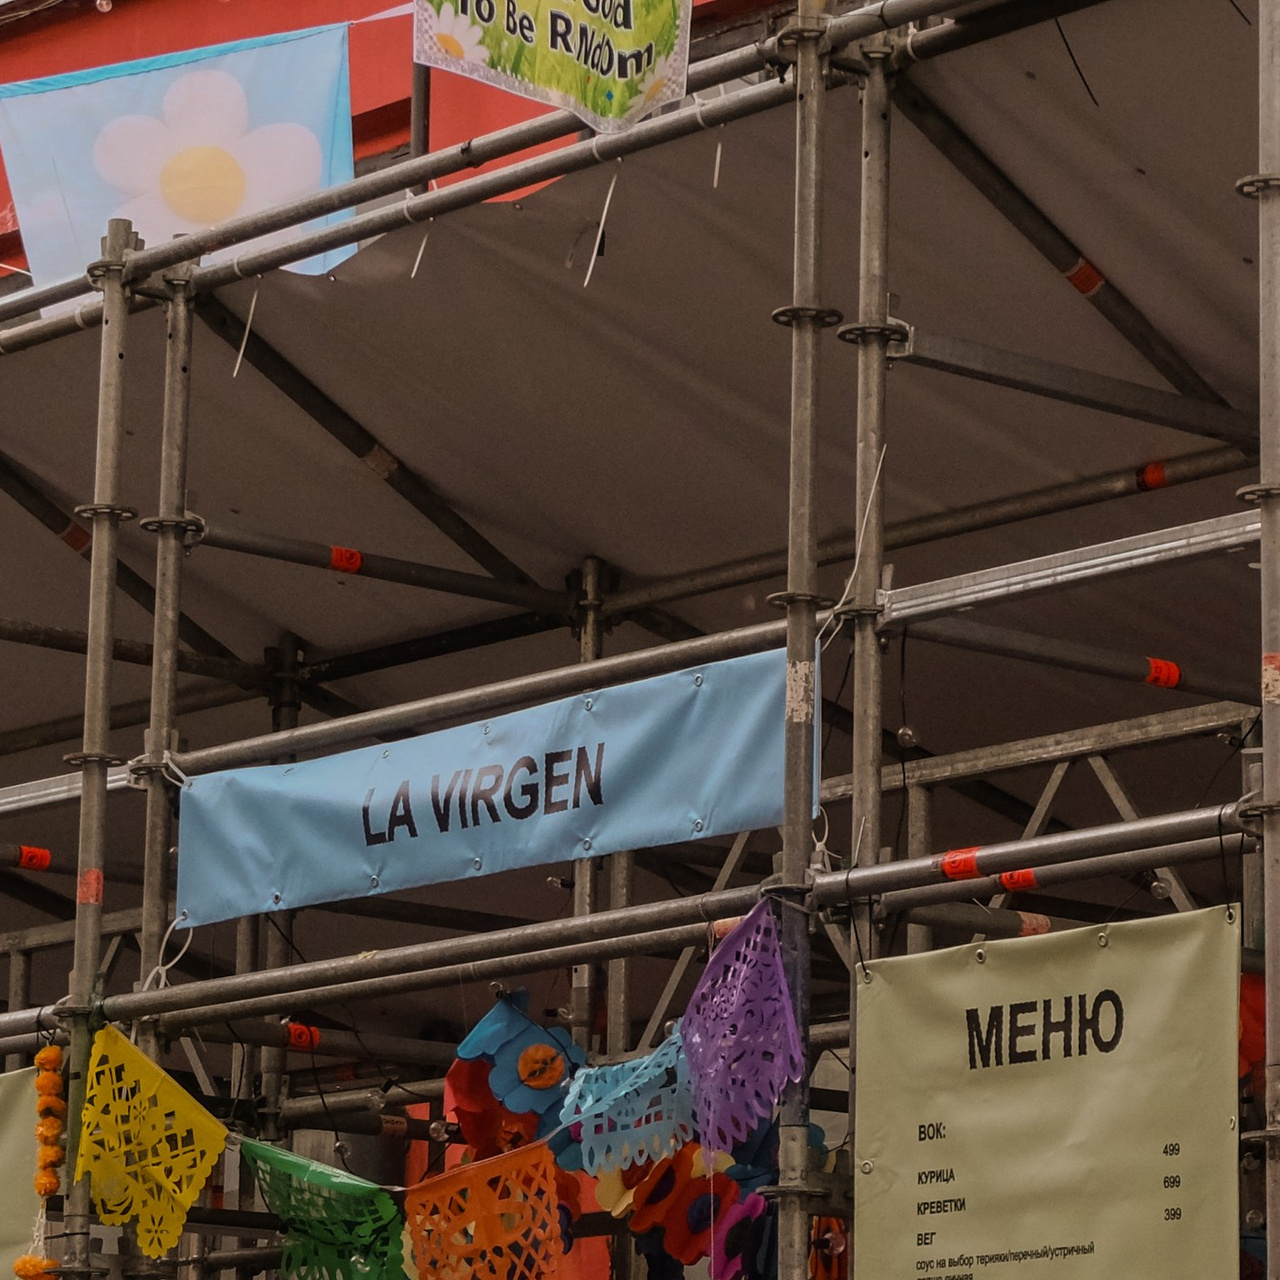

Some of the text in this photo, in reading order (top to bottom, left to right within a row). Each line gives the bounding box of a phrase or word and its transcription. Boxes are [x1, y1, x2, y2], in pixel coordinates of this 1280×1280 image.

[506, 0, 535, 43] Be
[362, 743, 605, 846] LA VIRGEN
[965, 989, 1124, 1070] МЕНЮ
[918, 1122, 946, 1141] ВОК:
[1162, 1143, 1180, 1156] 499
[917, 1168, 955, 1185] КУРИЦА
[1163, 1175, 1181, 1189] 699
[917, 1198, 966, 1215] КРЕВЕТКИ
[1164, 1207, 1182, 1221] 399
[917, 1232, 936, 1246] ВЕГ
[916, 1259, 935, 1272] соус
[936, 1258, 946, 1269] на
[948, 1254, 974, 1268] выбор
